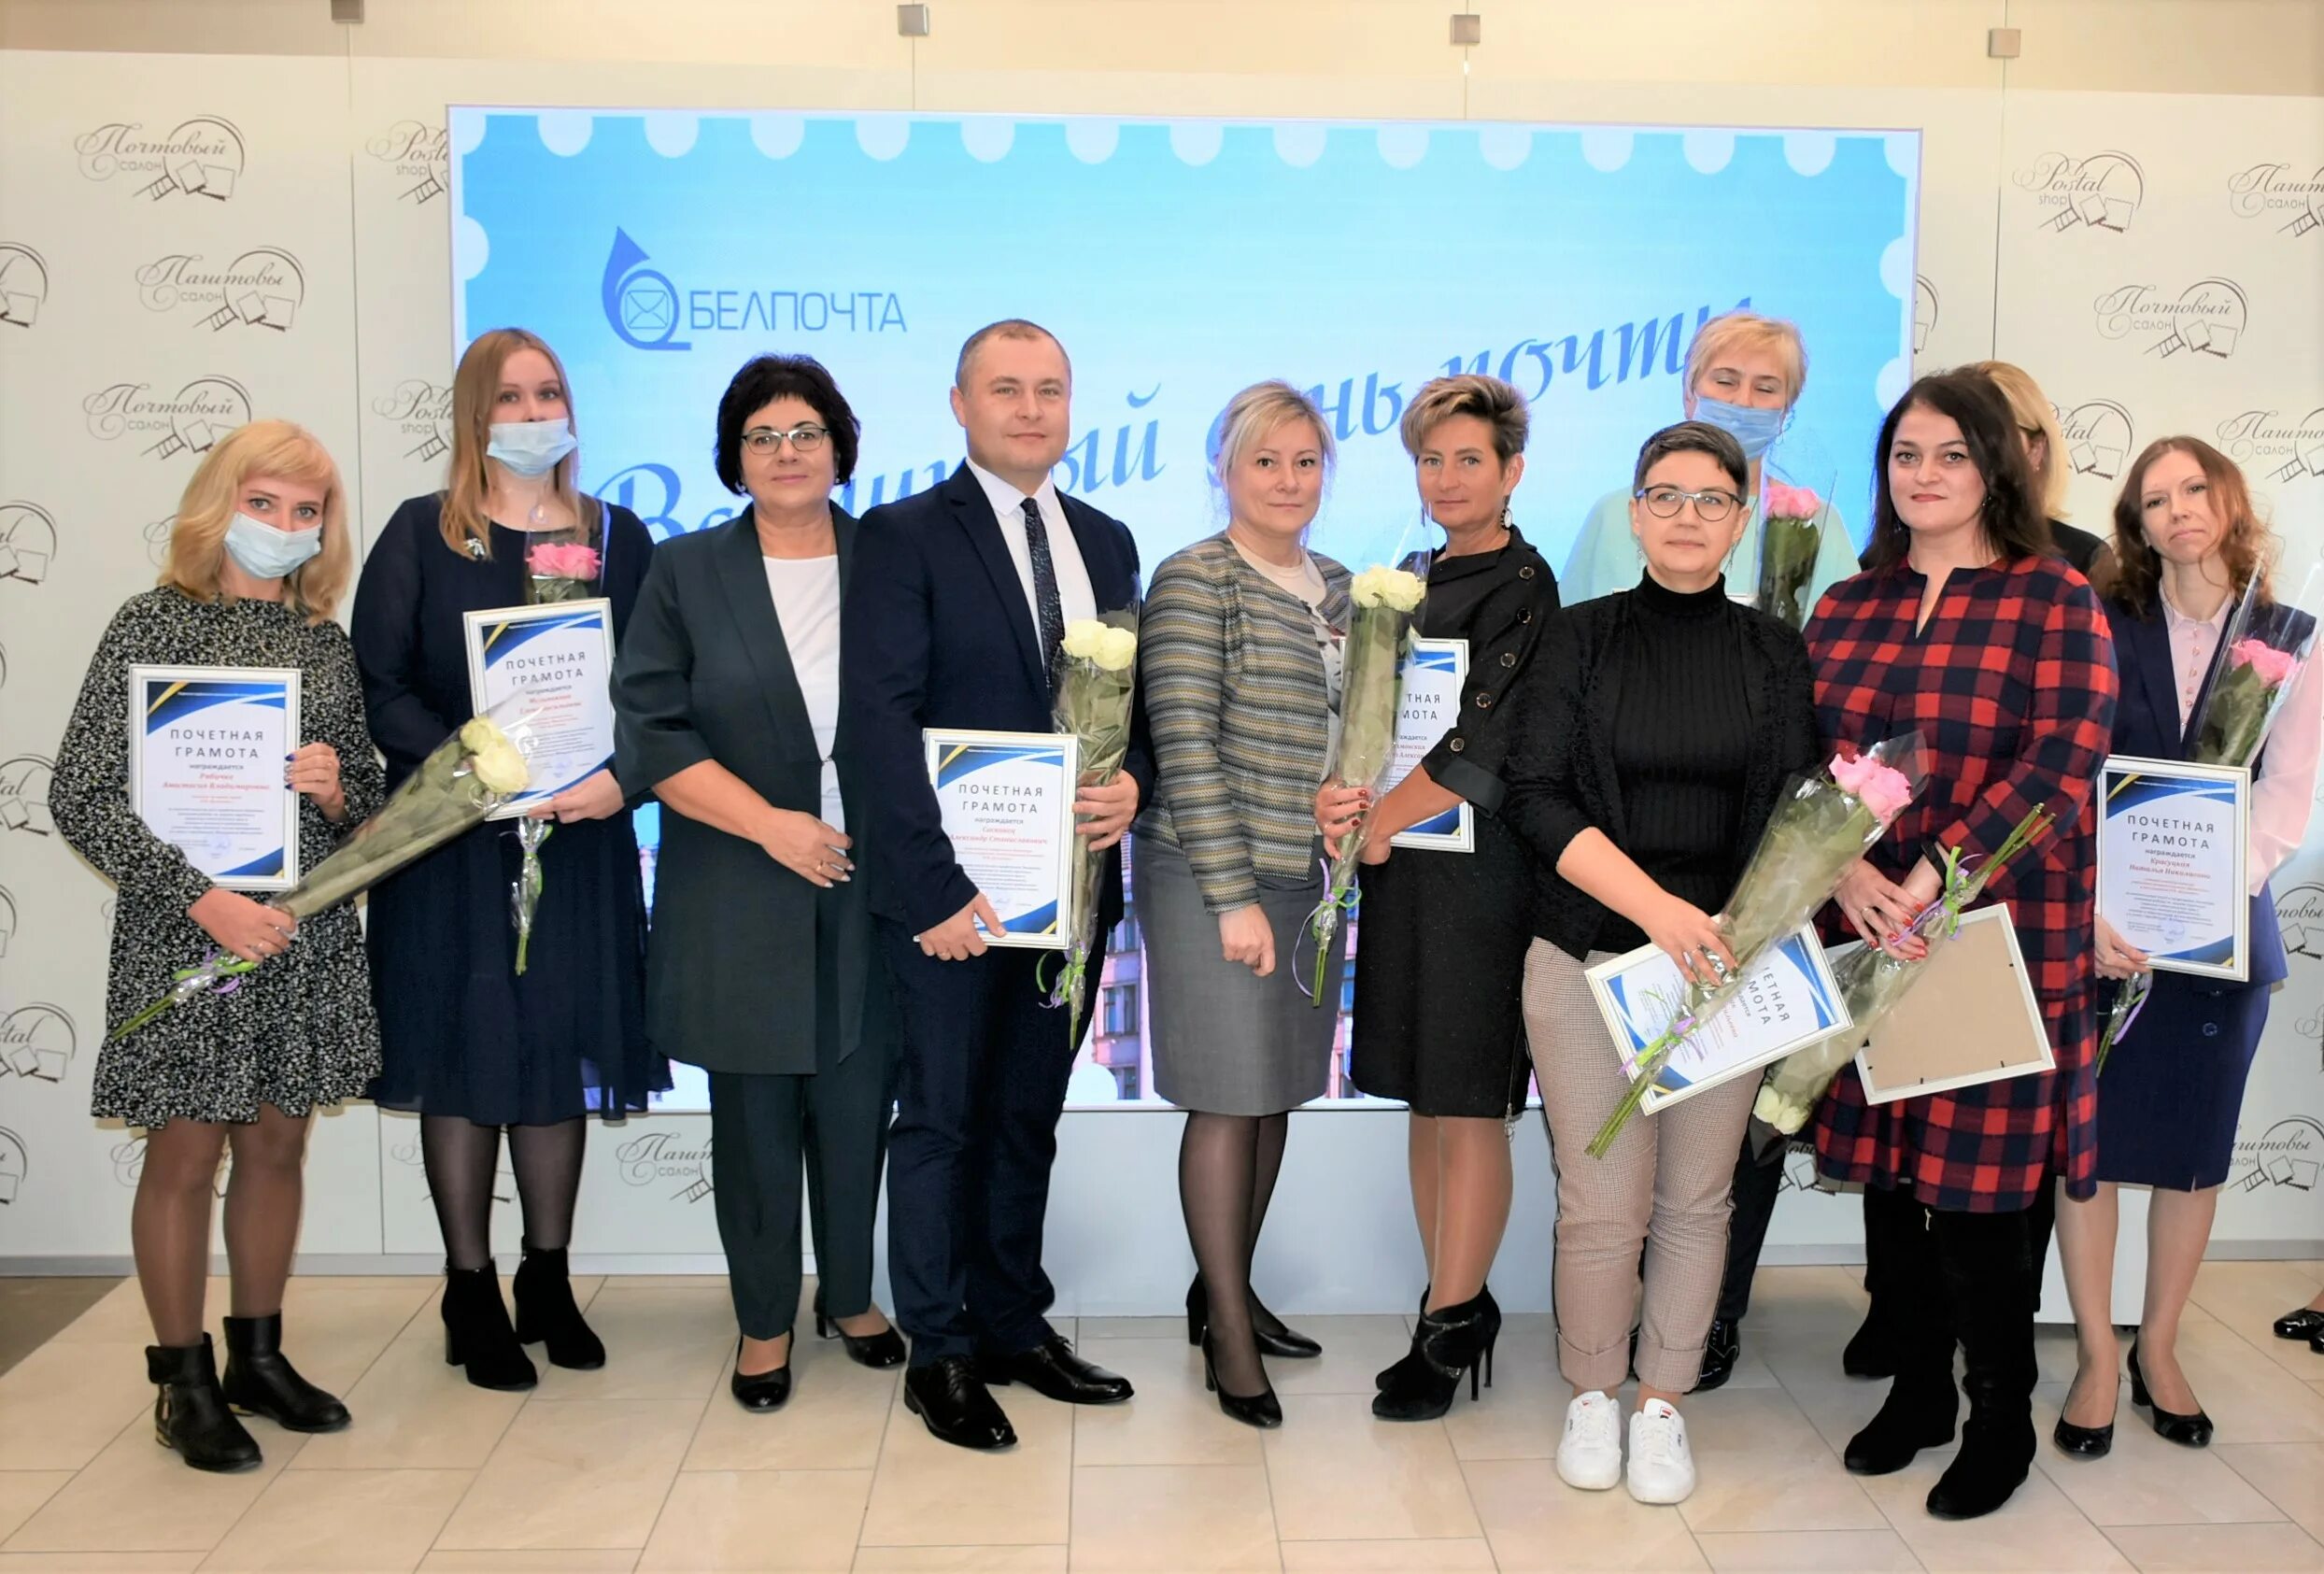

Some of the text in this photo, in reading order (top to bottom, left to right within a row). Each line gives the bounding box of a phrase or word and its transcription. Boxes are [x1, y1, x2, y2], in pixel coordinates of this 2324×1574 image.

[75, 123, 227, 157] Почтовый
[119, 160, 163, 172] салон
[395, 163, 428, 177] shop
[2011, 150, 2125, 192] Postal
[2037, 192, 2068, 207] shop
[2266, 198, 2306, 209] салон
[135, 254, 284, 288] Паштовы
[179, 291, 223, 303] салон
[2093, 284, 2232, 316] Почтовый
[689, 290, 908, 333] БЕЛПОЧТА
[2133, 319, 2172, 331] салон
[82, 383, 234, 417] Почтовый
[127, 419, 170, 432] салон
[400, 422, 433, 436] shop
[2255, 445, 2294, 456] салон
[505, 651, 587, 671] ПОЧЕТНАЯ
[512, 668, 584, 686] ГРАМОТА
[1406, 692, 1441, 704] ТНАЯ
[170, 729, 264, 742] ПОЧЕТНАЯ
[175, 746, 259, 759] ГРАМОТА
[957, 784, 1043, 797] ПОЧЕТНАЯ
[962, 801, 1038, 814] ГРАМОТА
[2127, 815, 2216, 833] ПОЧЕТНАЯ
[2132, 831, 2210, 849] ГРАМОТА
[1748, 980, 1772, 1026] МОТА
[1763, 969, 1792, 1023] ЕТНАЯ
[658, 1166, 699, 1177] салон
